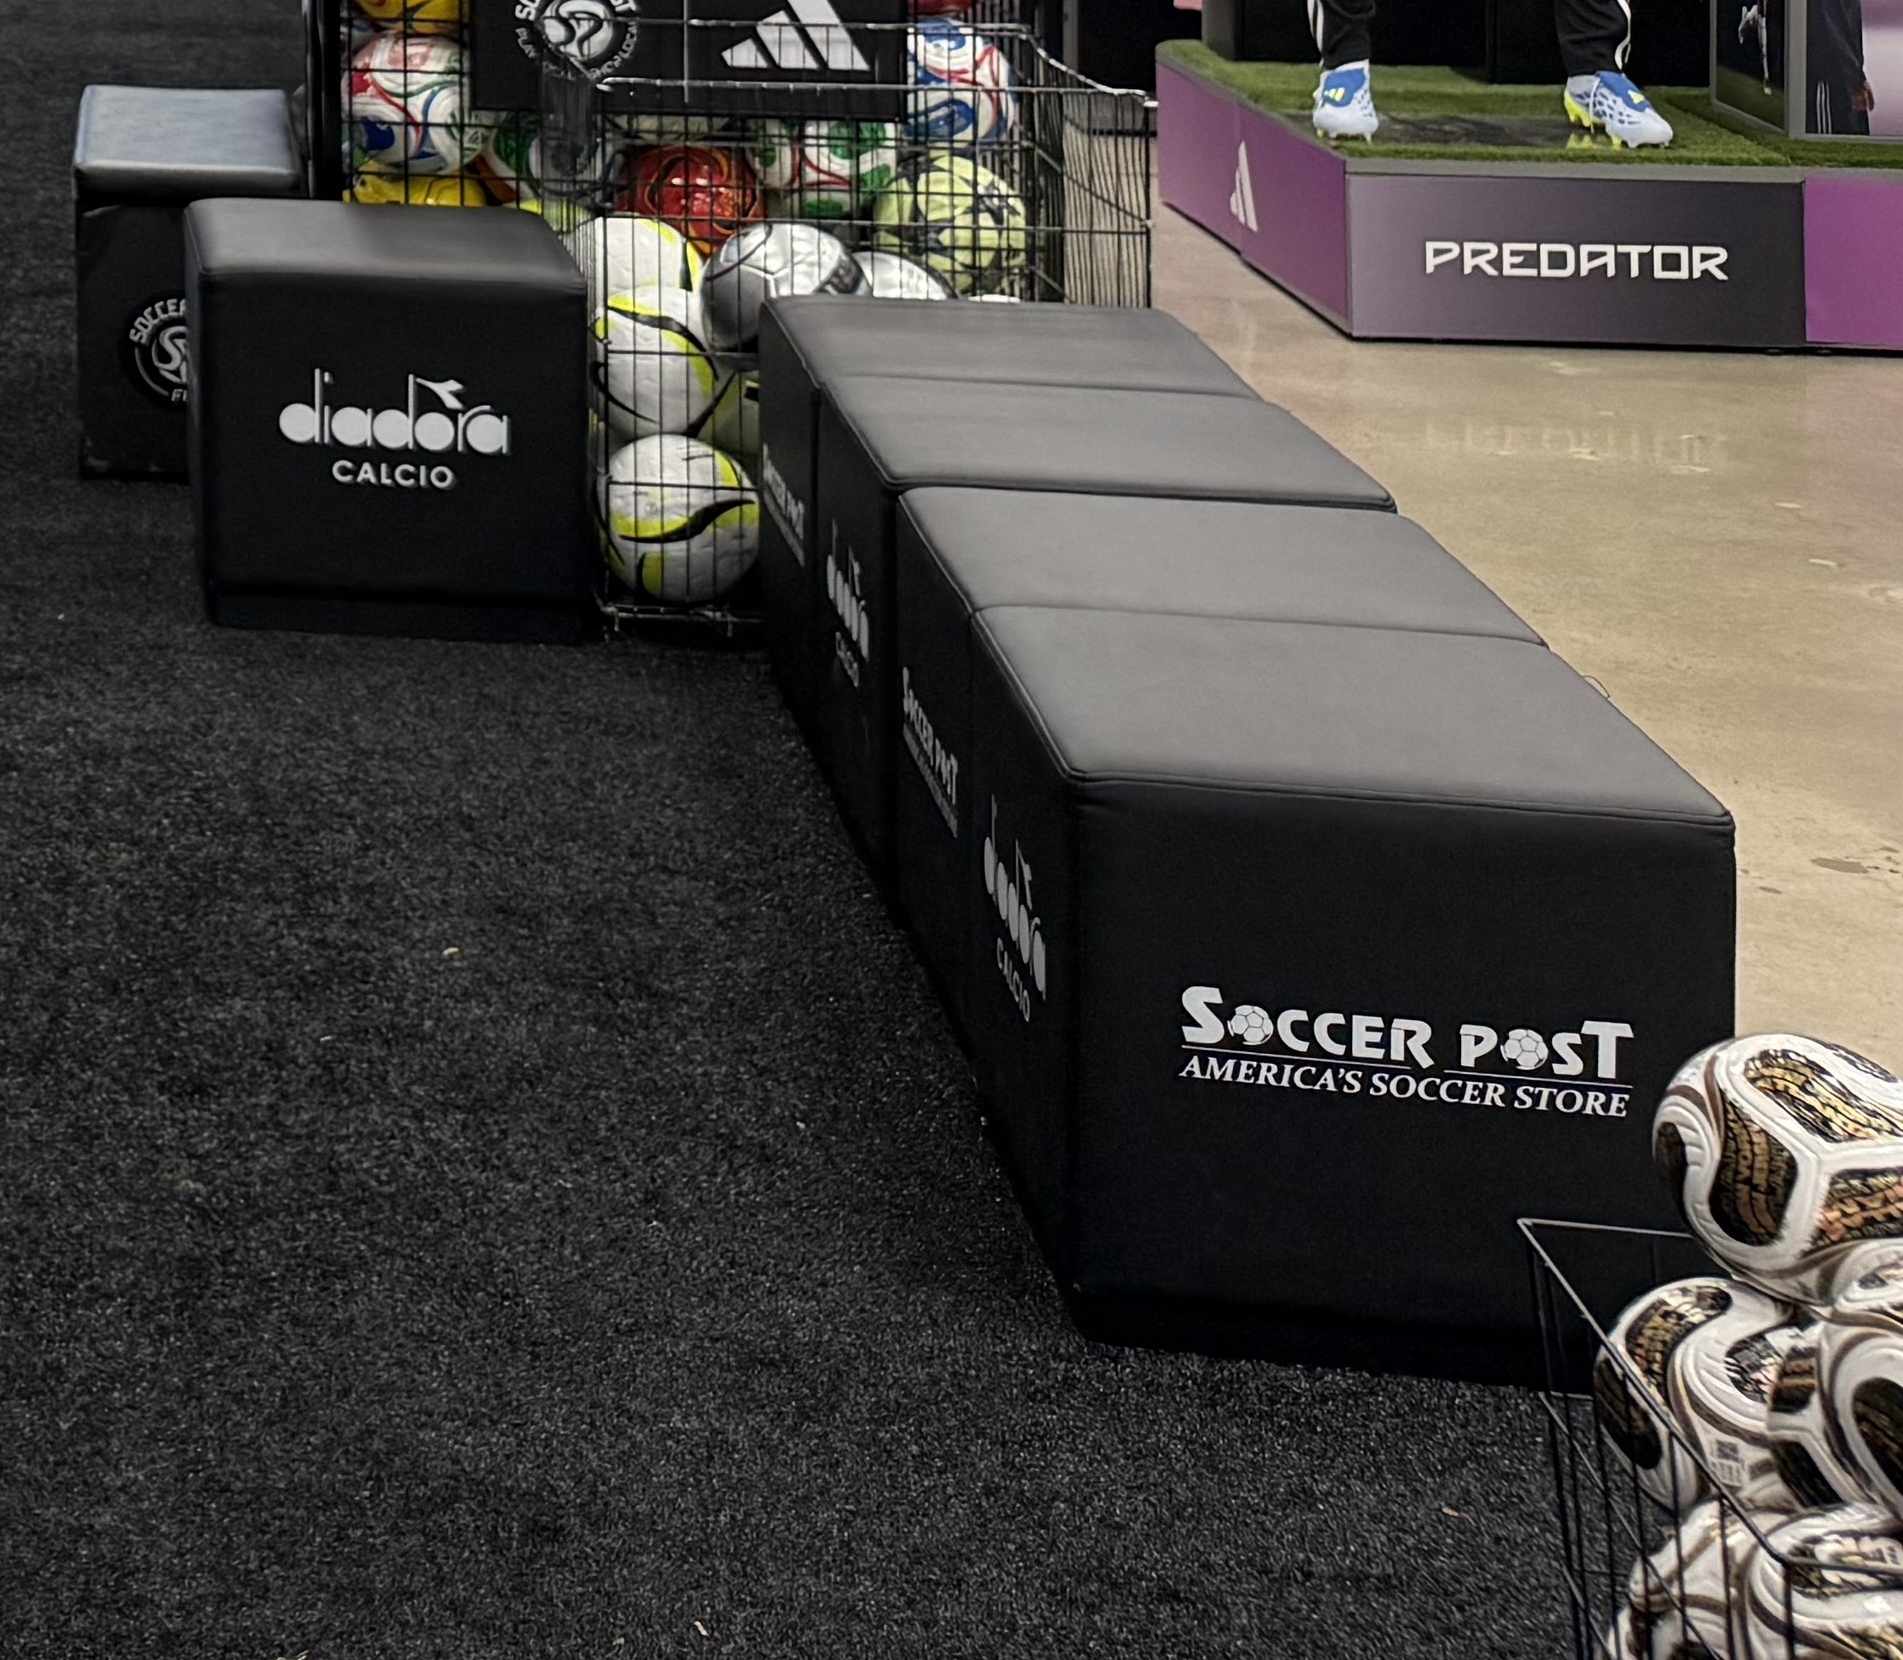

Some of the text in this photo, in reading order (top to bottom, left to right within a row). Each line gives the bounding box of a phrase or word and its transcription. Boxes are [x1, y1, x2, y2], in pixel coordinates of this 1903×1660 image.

[1425, 240, 1729, 281] PREDATOR
[279, 368, 510, 455] diadora
[332, 459, 455, 490] CALCIO
[996, 936, 1031, 1022] CALCIO
[1178, 1055, 1631, 1119] AMERICA'S SOCCER STORE
